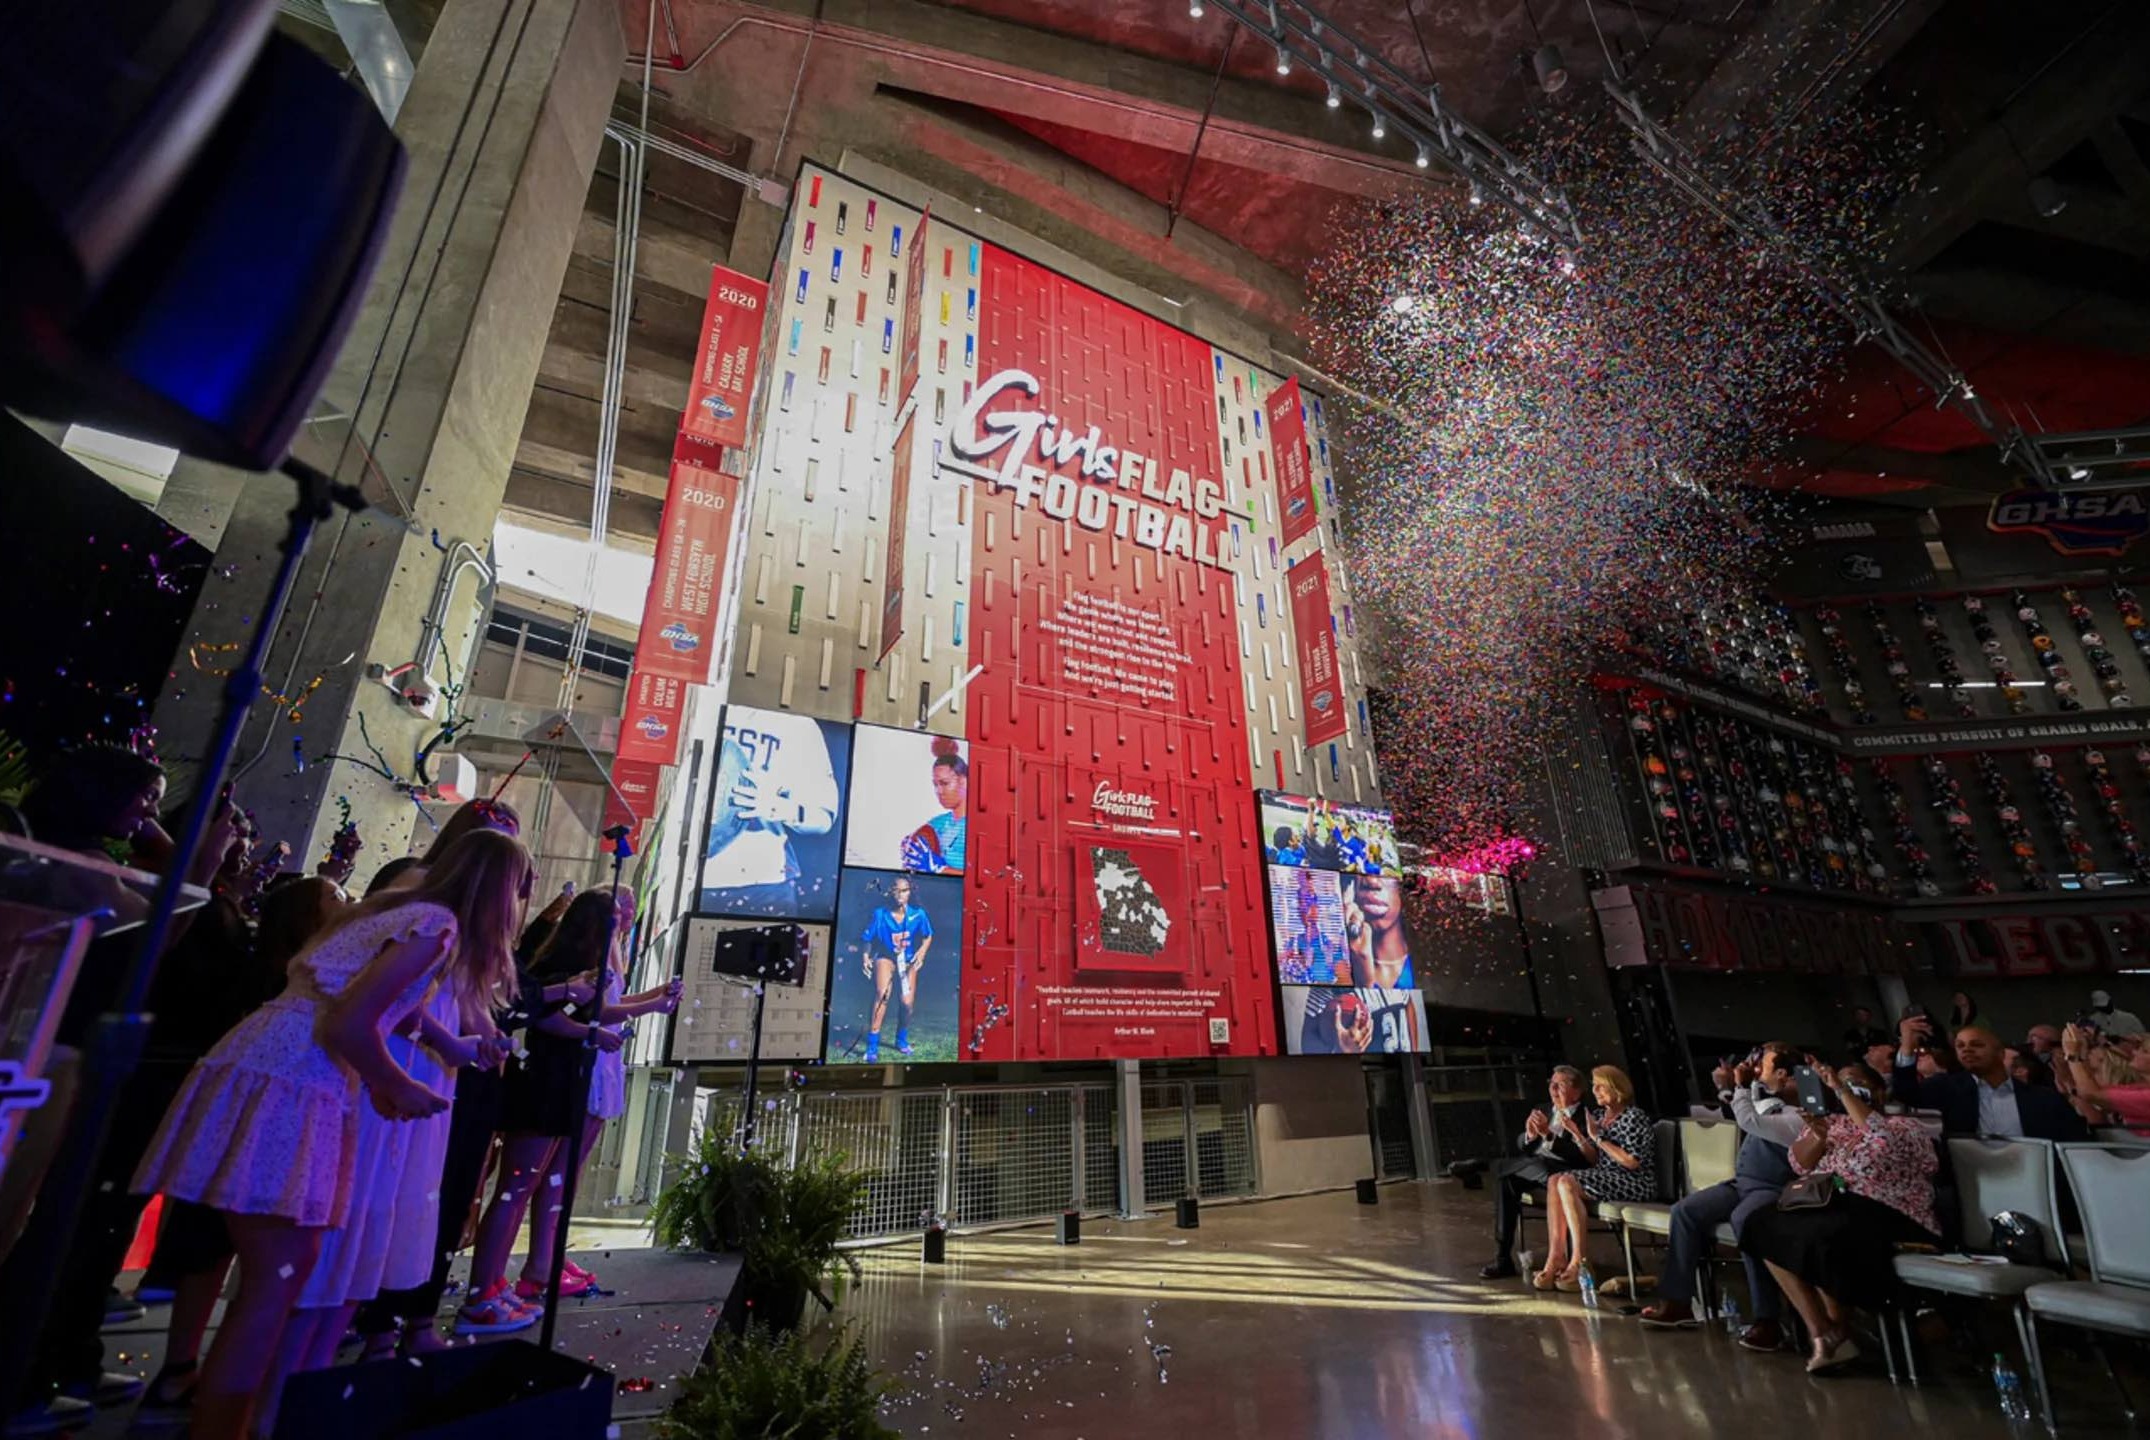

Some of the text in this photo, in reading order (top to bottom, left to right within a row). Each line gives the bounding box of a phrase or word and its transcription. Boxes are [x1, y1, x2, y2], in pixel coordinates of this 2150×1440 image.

[717, 285, 758, 310] 2020
[1273, 397, 1294, 422] 2021
[952, 368, 1120, 488] Girls
[1118, 450, 1221, 520] FLAG
[681, 487, 725, 510] 2020
[1996, 494, 2150, 526] GHSA
[1014, 463, 1235, 574] FOOTBALL
[681, 539, 704, 612] WEST FORSYTH
[699, 553, 716, 590] SCHOOL
[1295, 575, 1319, 598] 2021
[1853, 732, 1938, 749] COMMITTED
[1940, 728, 2004, 743] PURSUIT
[2007, 727, 2025, 740] OF
[2029, 723, 2087, 738] SHARED
[1104, 802, 1155, 820] FOOTBALL
[1127, 792, 1153, 807] FLAG
